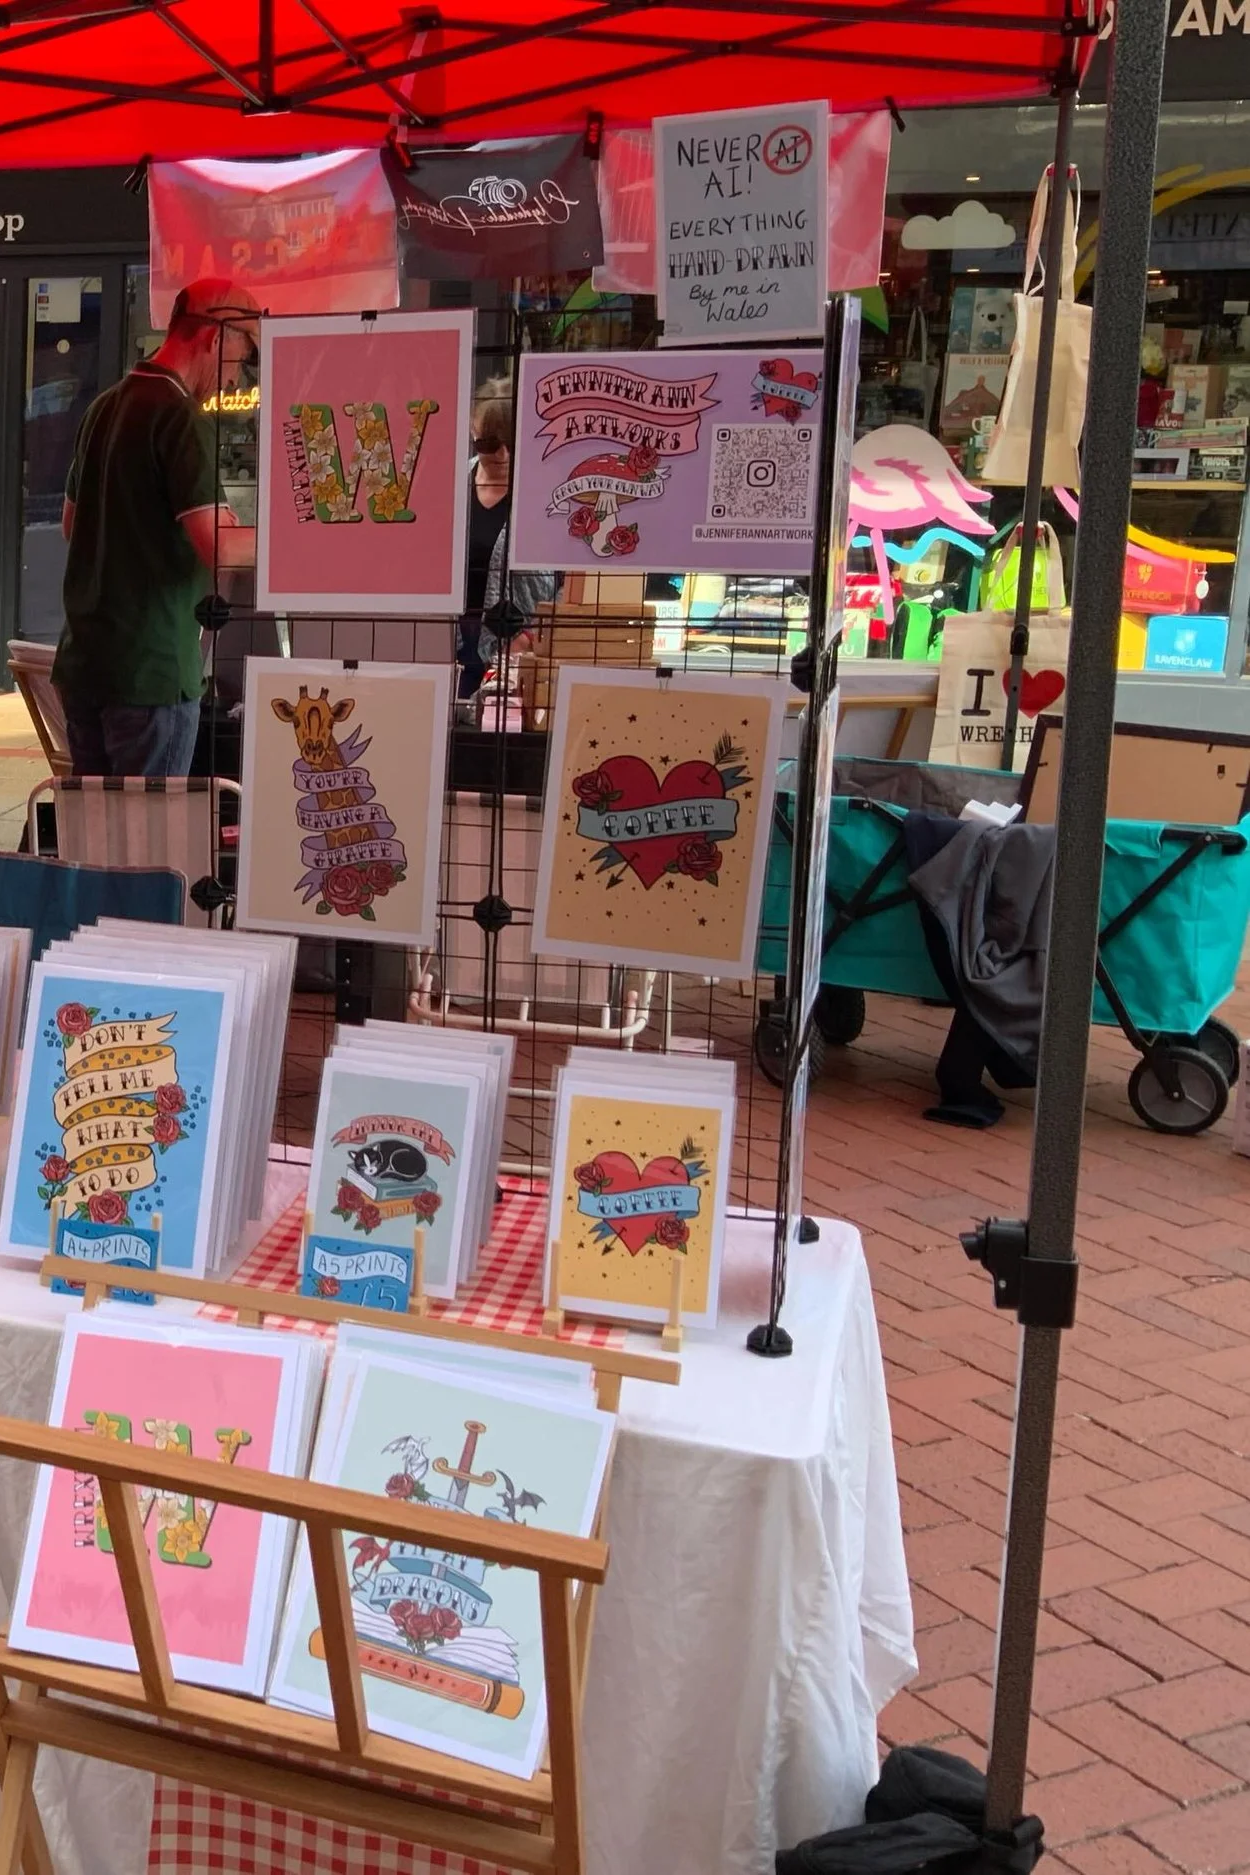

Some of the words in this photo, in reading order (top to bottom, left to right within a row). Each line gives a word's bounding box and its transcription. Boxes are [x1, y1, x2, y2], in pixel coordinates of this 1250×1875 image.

[677, 133, 762, 168] NEVER
[704, 162, 753, 199] AI!
[669, 209, 808, 240] EVERYTHING
[668, 241, 815, 279] HAND-DRAWN
[689, 284, 717, 307] By
[723, 286, 749, 296] me
[756, 279, 781, 294] in
[706, 300, 768, 322] Wales
[541, 370, 648, 404] JENNIFER
[649, 383, 697, 410] ANN
[564, 415, 681, 450] ARTWORKS
[283, 418, 316, 524] WREXHAM
[555, 477, 584, 500] GROW
[587, 476, 614, 490] YOUR
[615, 481, 639, 497] OWN
[639, 483, 663, 498] WAY
[695, 528, 814, 540] @JENNIFERANNARTWORK
[1155, 654, 1213, 668] RAVENCLAW
[961, 668, 994, 717] I
[959, 725, 1034, 743] WREH
[299, 770, 364, 790] YOU'RE
[299, 808, 366, 829] HAVING
[369, 807, 384, 820] A
[602, 804, 715, 838] COFFEE
[313, 842, 393, 867] GIRAFFE
[80, 1023, 147, 1052] DON'T
[58, 1072, 114, 1108] TELL
[120, 1069, 155, 1091] ME
[76, 1120, 143, 1147] WHAT
[73, 1173, 100, 1197] TO
[107, 1167, 140, 1187] DO
[597, 1189, 684, 1216] COFFEE
[344, 1255, 406, 1277] PRINTS
[379, 1575, 481, 1622] DRAGONS
